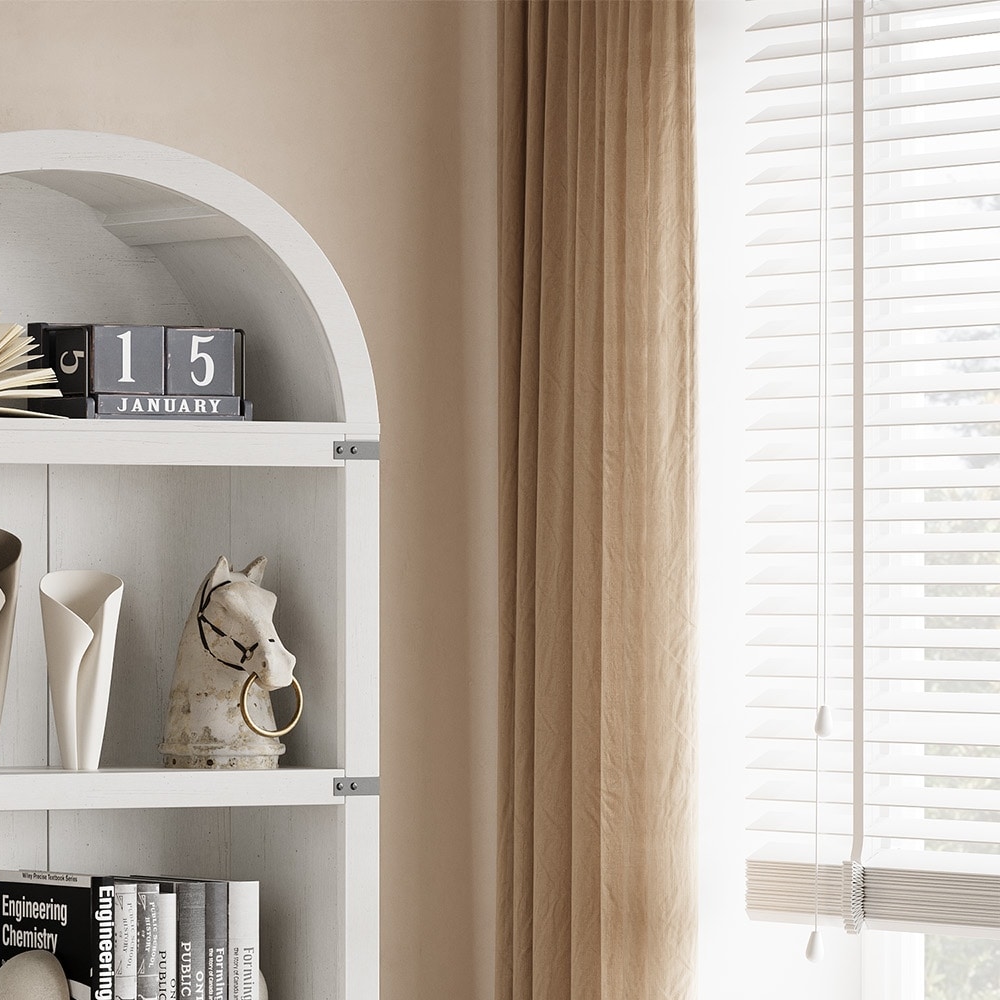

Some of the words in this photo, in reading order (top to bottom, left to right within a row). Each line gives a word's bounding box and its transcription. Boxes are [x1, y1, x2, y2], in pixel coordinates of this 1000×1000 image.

[116, 331, 135, 383] 1
[189, 335, 215, 387] 5
[115, 396, 221, 414] JANUARY
[2, 894, 68, 926] Engineering
[2, 923, 58, 954] Chemistry
[94, 885, 115, 1000] Engineering
[181, 942, 192, 997] PUBLIC
